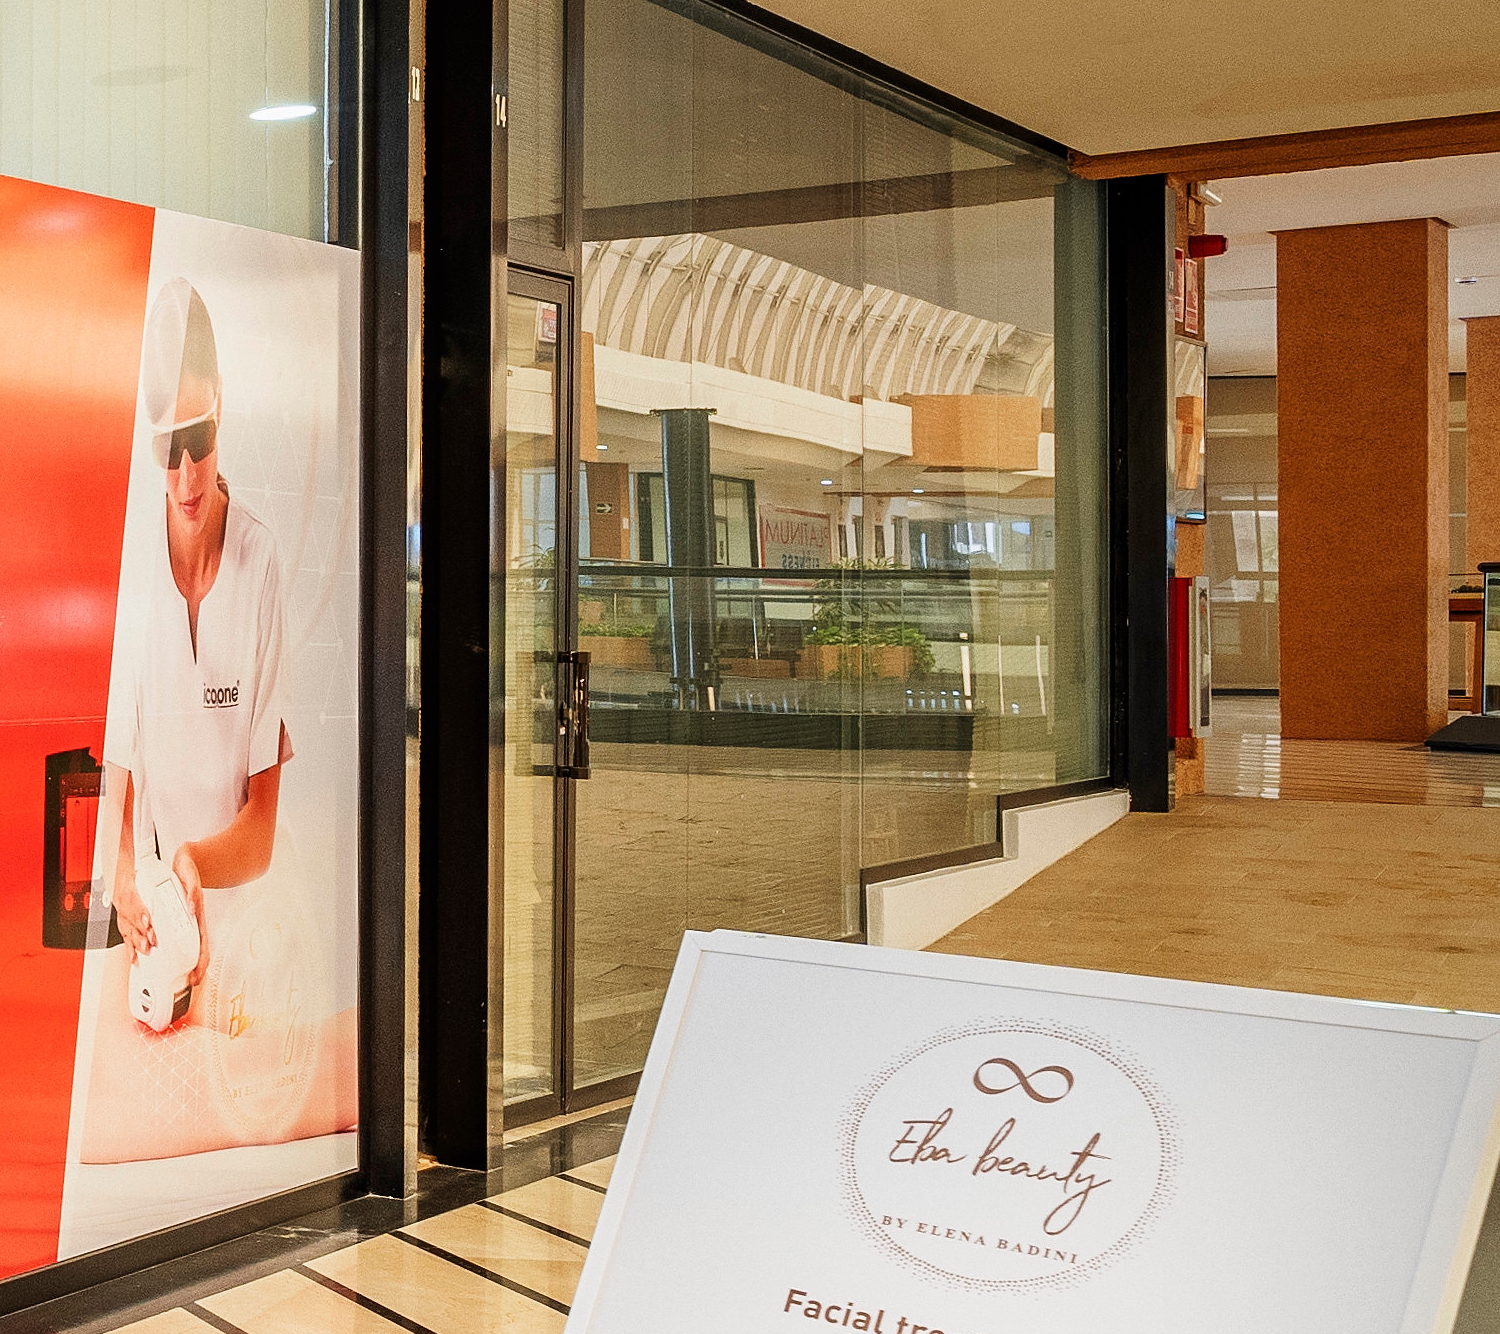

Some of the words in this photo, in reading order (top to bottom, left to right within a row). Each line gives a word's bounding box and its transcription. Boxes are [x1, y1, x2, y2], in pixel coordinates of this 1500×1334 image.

[888, 1107, 967, 1165] Eba
[972, 1117, 1112, 1236] beauty
[881, 1214, 909, 1230] BY
[917, 1222, 986, 1246] ELENA
[997, 1238, 1079, 1265] BADINI
[784, 1289, 885, 1334] Facial
